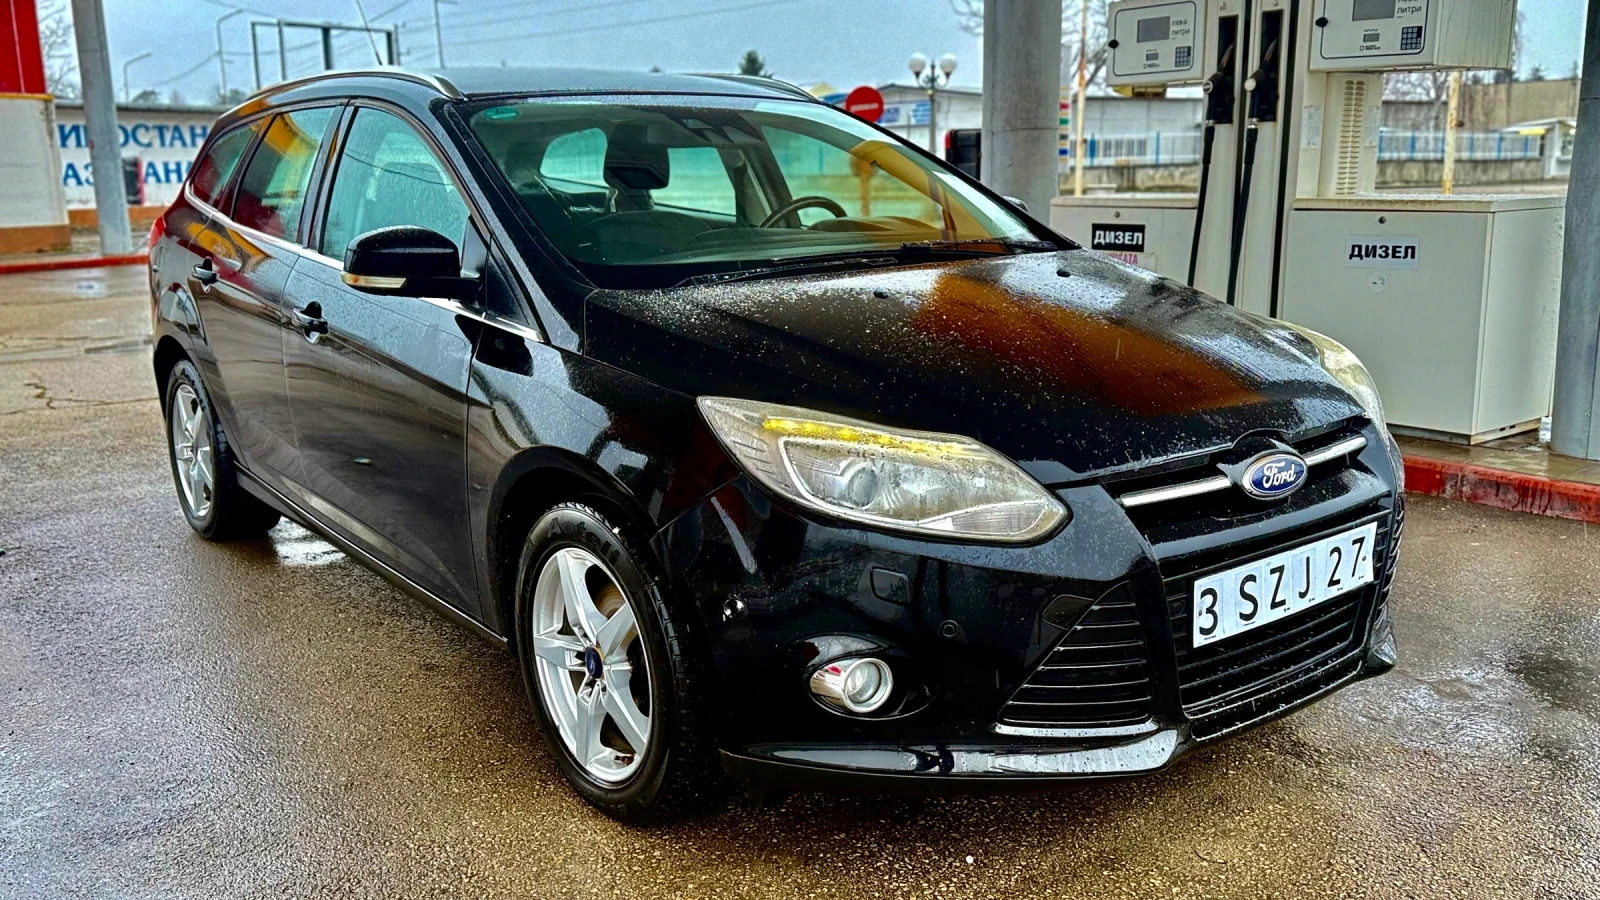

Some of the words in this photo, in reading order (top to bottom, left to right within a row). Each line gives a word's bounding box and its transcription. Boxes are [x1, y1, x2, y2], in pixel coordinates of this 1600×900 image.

[1396, 6, 1422, 15] литри
[1171, 19, 1188, 27] лева
[1171, 28, 1191, 36] литри
[58, 123, 207, 148] ИСТАН
[1093, 230, 1143, 246] ДИЗЕЛ
[1348, 244, 1416, 260] ДИЗЕЛ
[1262, 461, 1296, 488] Ford
